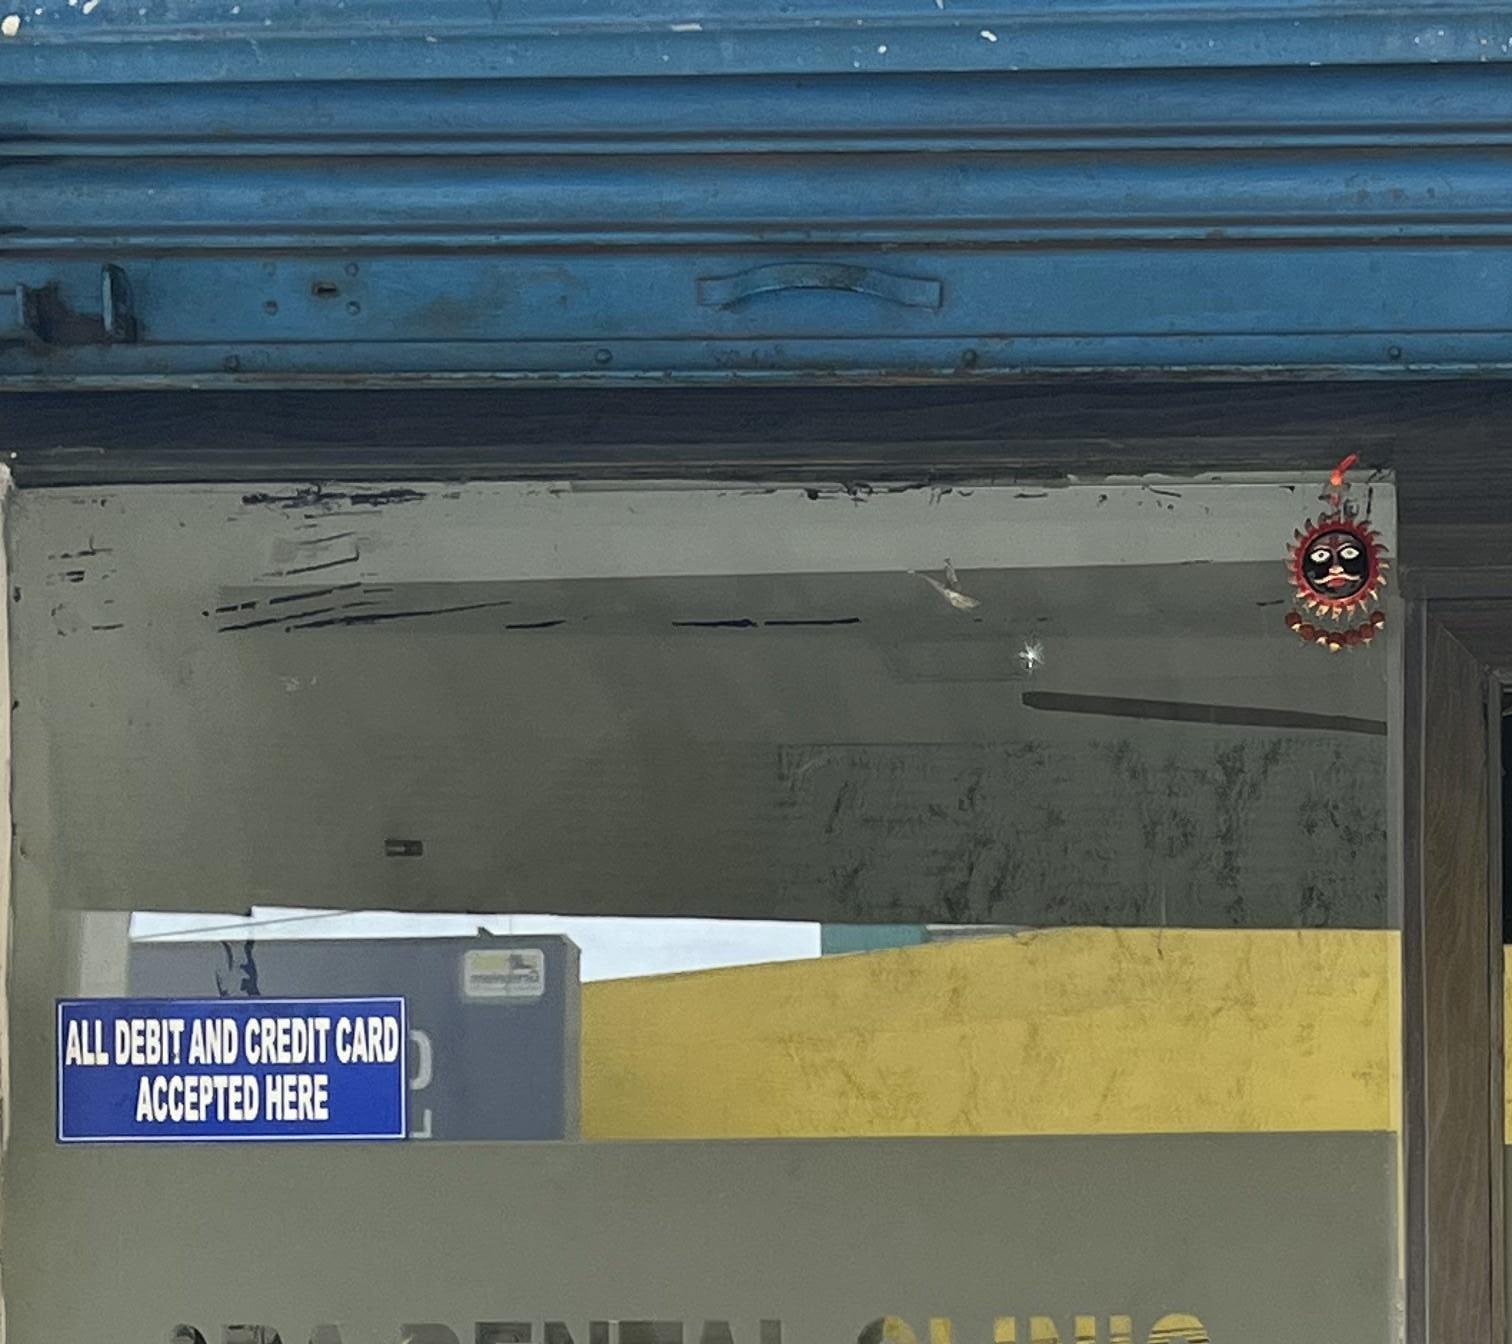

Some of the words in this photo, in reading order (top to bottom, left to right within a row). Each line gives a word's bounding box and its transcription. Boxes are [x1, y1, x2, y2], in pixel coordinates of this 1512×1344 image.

[65, 1019, 109, 1065] ALL
[115, 1018, 185, 1065] DEBIT
[188, 1018, 238, 1065] AND
[245, 1017, 330, 1064] CREDIT
[335, 1016, 399, 1063] CARD
[136, 1075, 259, 1122] ACCEPTED
[265, 1074, 329, 1121] HERE
